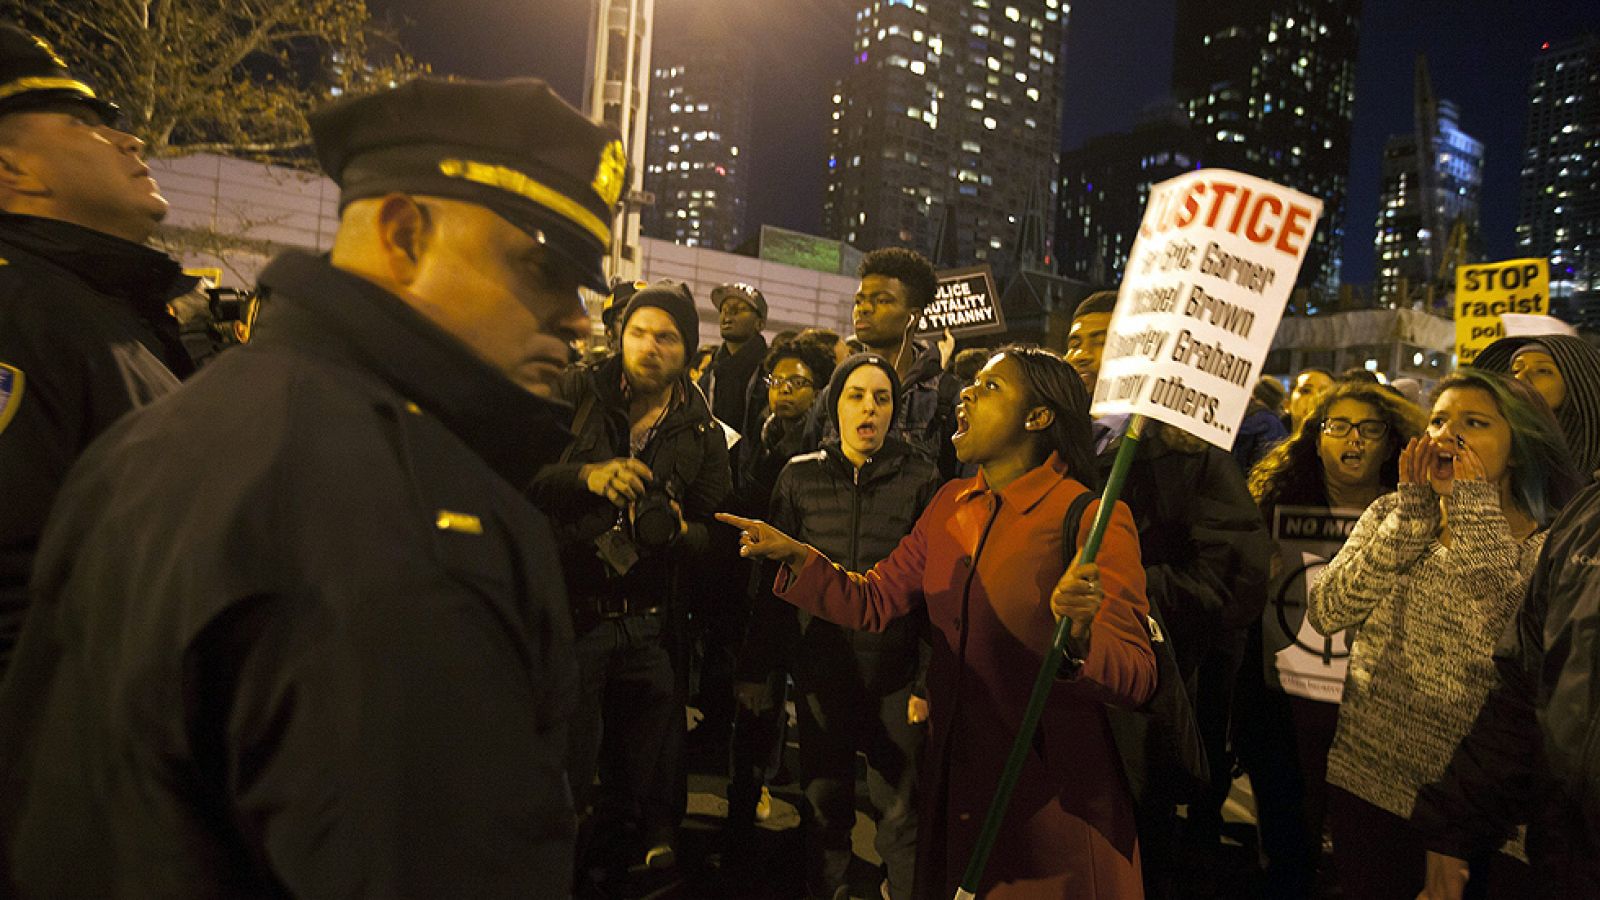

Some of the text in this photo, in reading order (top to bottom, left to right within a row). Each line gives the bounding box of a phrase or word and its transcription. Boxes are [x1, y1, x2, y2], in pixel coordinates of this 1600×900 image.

[1200, 241, 1275, 294] Garner
[1464, 265, 1539, 291] STOP
[929, 307, 992, 328] TYRANNY
[1184, 285, 1255, 339] Brown
[1461, 293, 1542, 317] racist
[1472, 321, 1502, 340] pol
[1171, 329, 1252, 388] Graham
[1150, 376, 1231, 433] others...
[1286, 517, 1318, 536] NO
